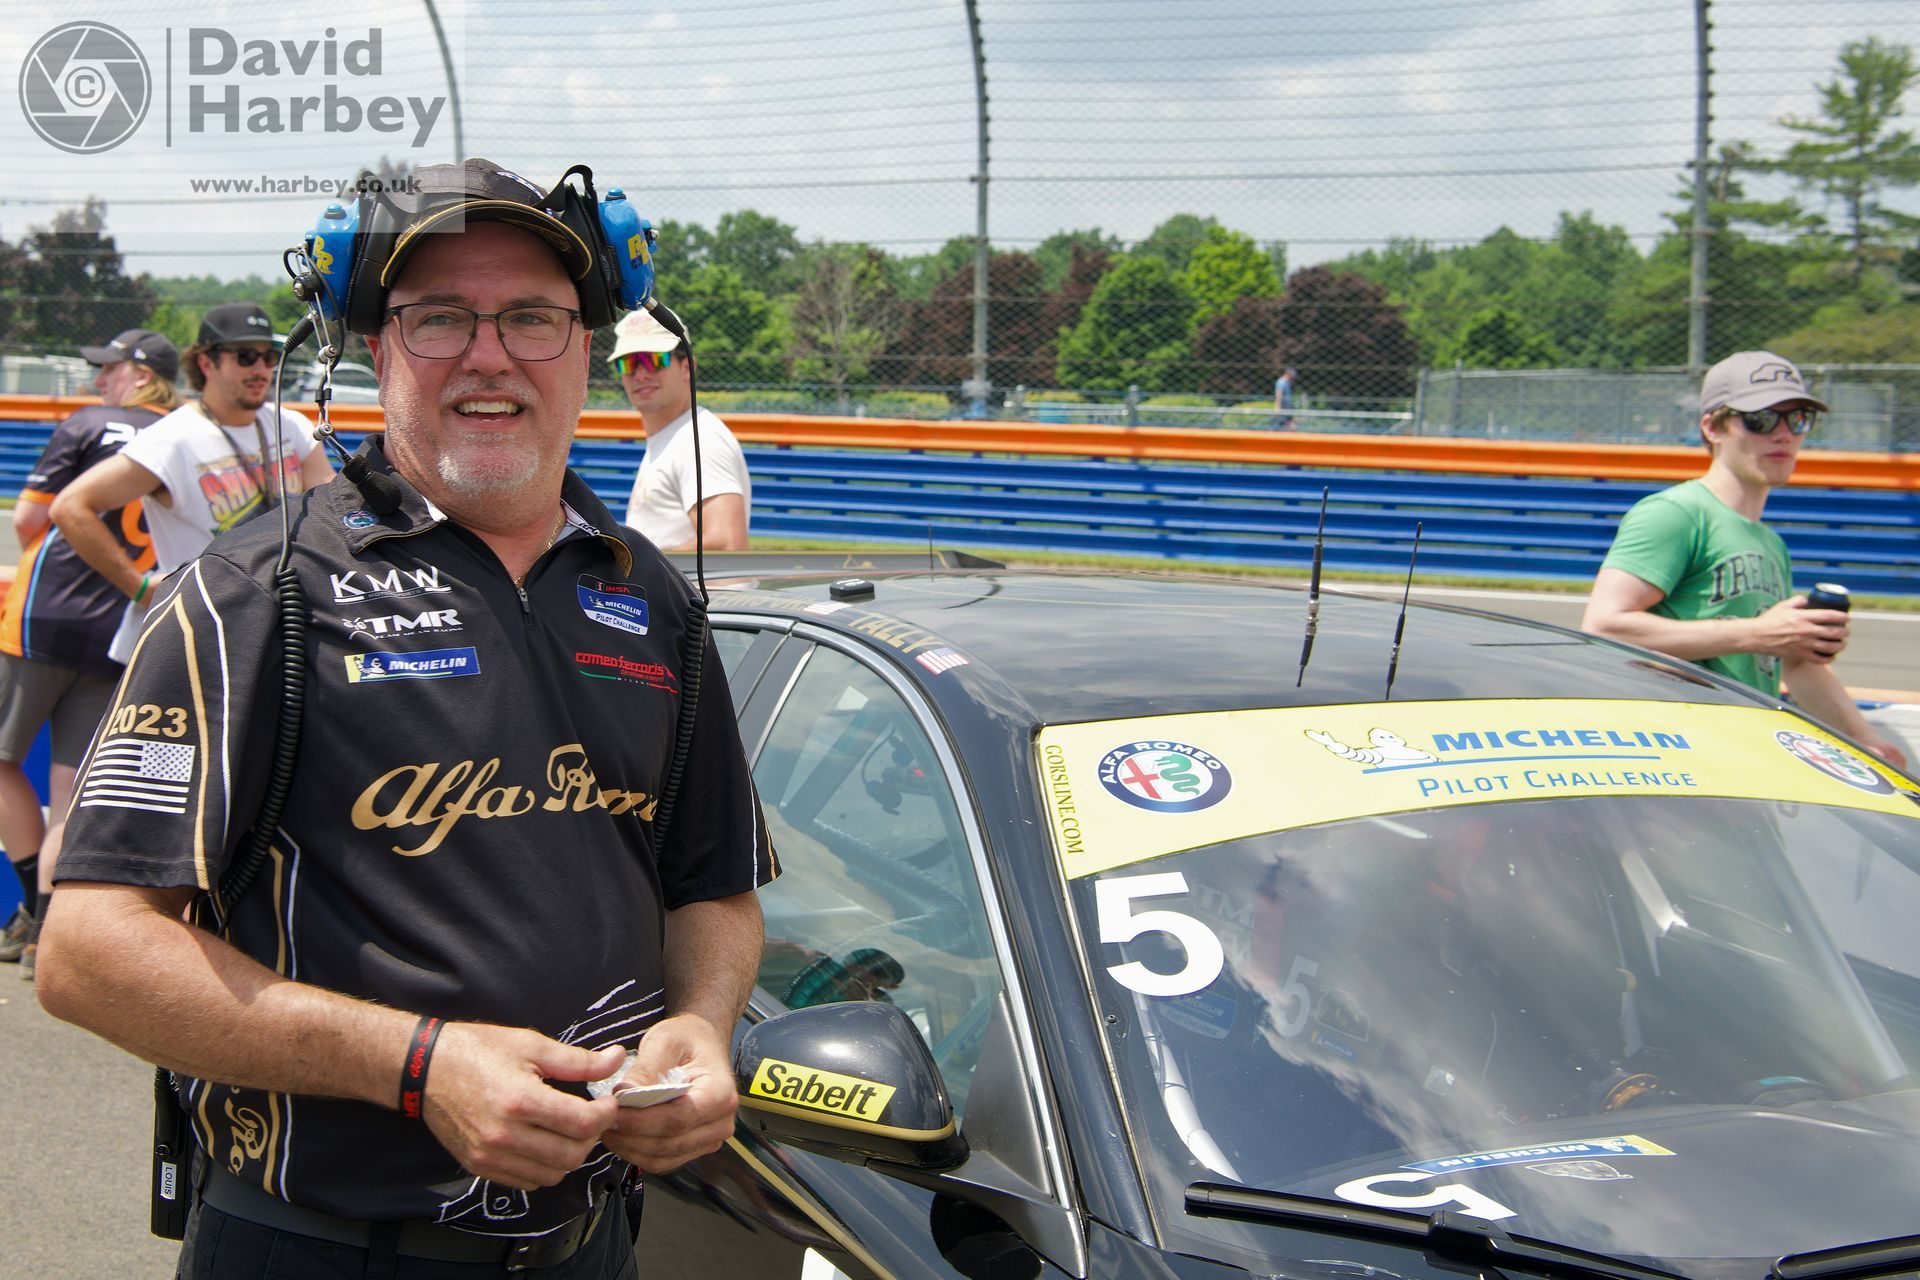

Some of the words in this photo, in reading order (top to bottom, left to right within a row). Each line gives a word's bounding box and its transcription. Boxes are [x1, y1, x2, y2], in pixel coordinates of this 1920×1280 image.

[329, 565, 440, 599] KMW
[364, 608, 463, 634] TMR
[605, 601, 643, 617] MICHELIN
[388, 657, 467, 671] MICHELIN
[108, 704, 188, 738] 2023
[1432, 730, 1692, 751] MICHELIN
[1100, 750, 1129, 784] ALFA
[1133, 742, 1222, 770] ROMEO
[1418, 774, 1509, 797] PILOT
[1524, 769, 1698, 787] CHALLENGE
[351, 757, 536, 857] Alfa
[1045, 744, 1084, 855] GORSLINE.COM
[1095, 871, 1225, 997] 5
[760, 1063, 877, 1115] Sabelt
[1437, 1143, 1591, 1167] MICHELIN
[164, 1166, 173, 1195] LOUIS
